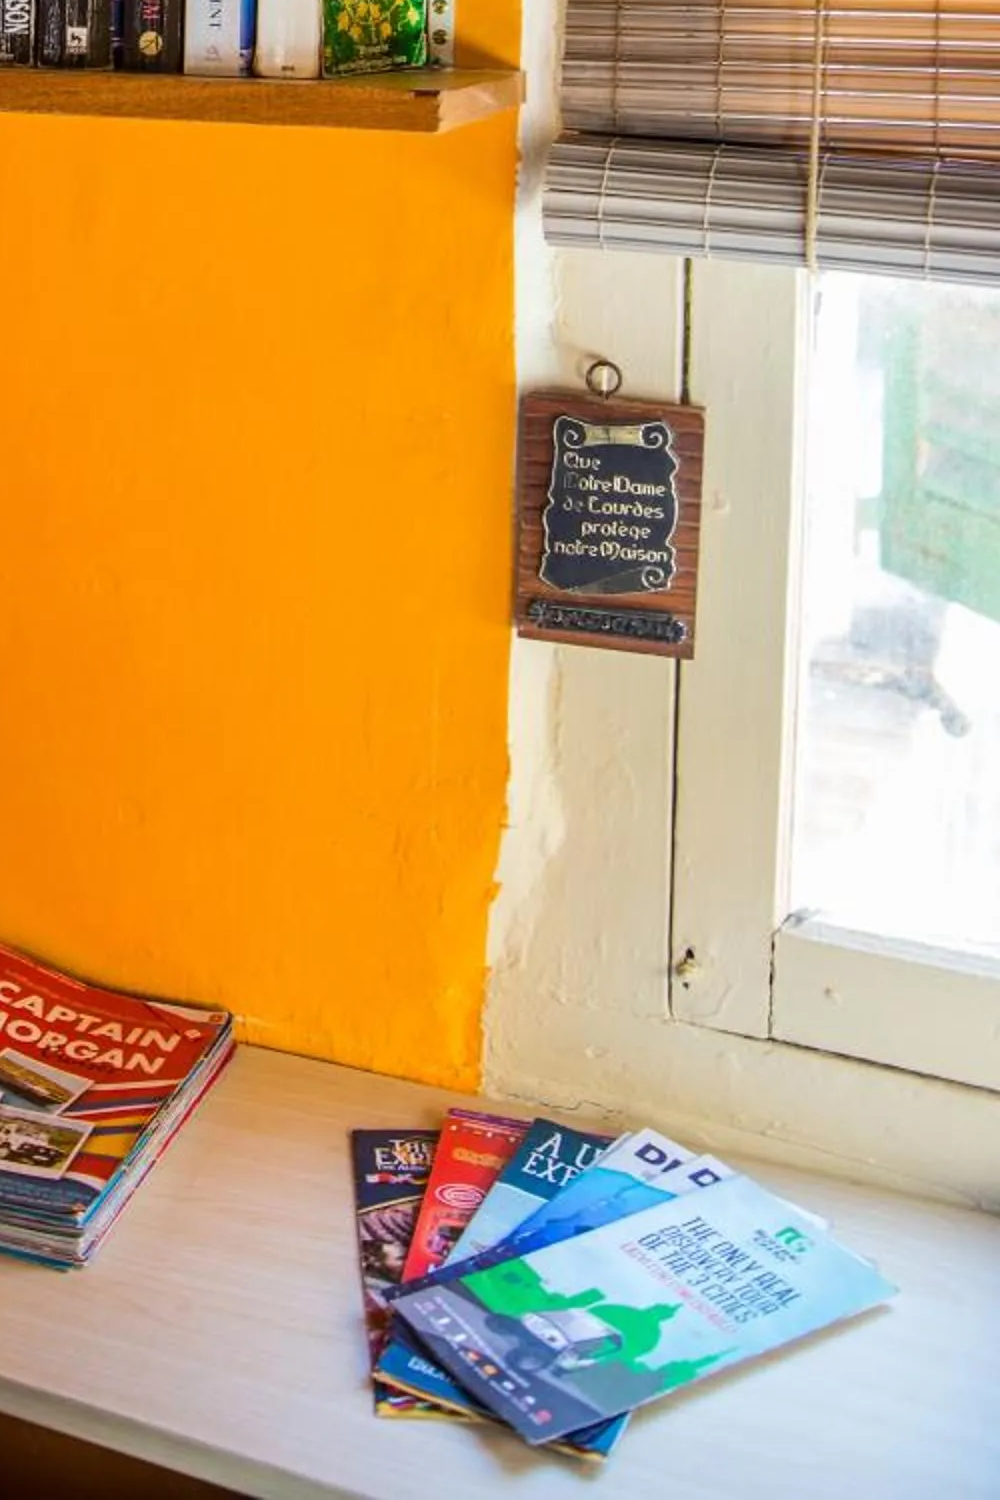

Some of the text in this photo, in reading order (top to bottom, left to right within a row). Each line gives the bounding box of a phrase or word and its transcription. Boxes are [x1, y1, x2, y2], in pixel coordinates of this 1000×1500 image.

[562, 452, 601, 471] Que
[613, 475, 667, 497] Dame
[563, 496, 665, 519] de Lourdes
[554, 540, 668, 564] notre Maison
[536, 1132, 562, 1159] A
[634, 1142, 686, 1172] DI
[522, 1152, 580, 1187] EXP
[688, 1168, 722, 1187] D
[659, 1225, 742, 1284] DISCOVERY
[735, 1282, 779, 1317] TOUR
[682, 1216, 722, 1243] THE
[711, 1241, 764, 1273] ONLY
[751, 1271, 802, 1308] REAL
[638, 1232, 749, 1325] OF THE 3 CITIES
